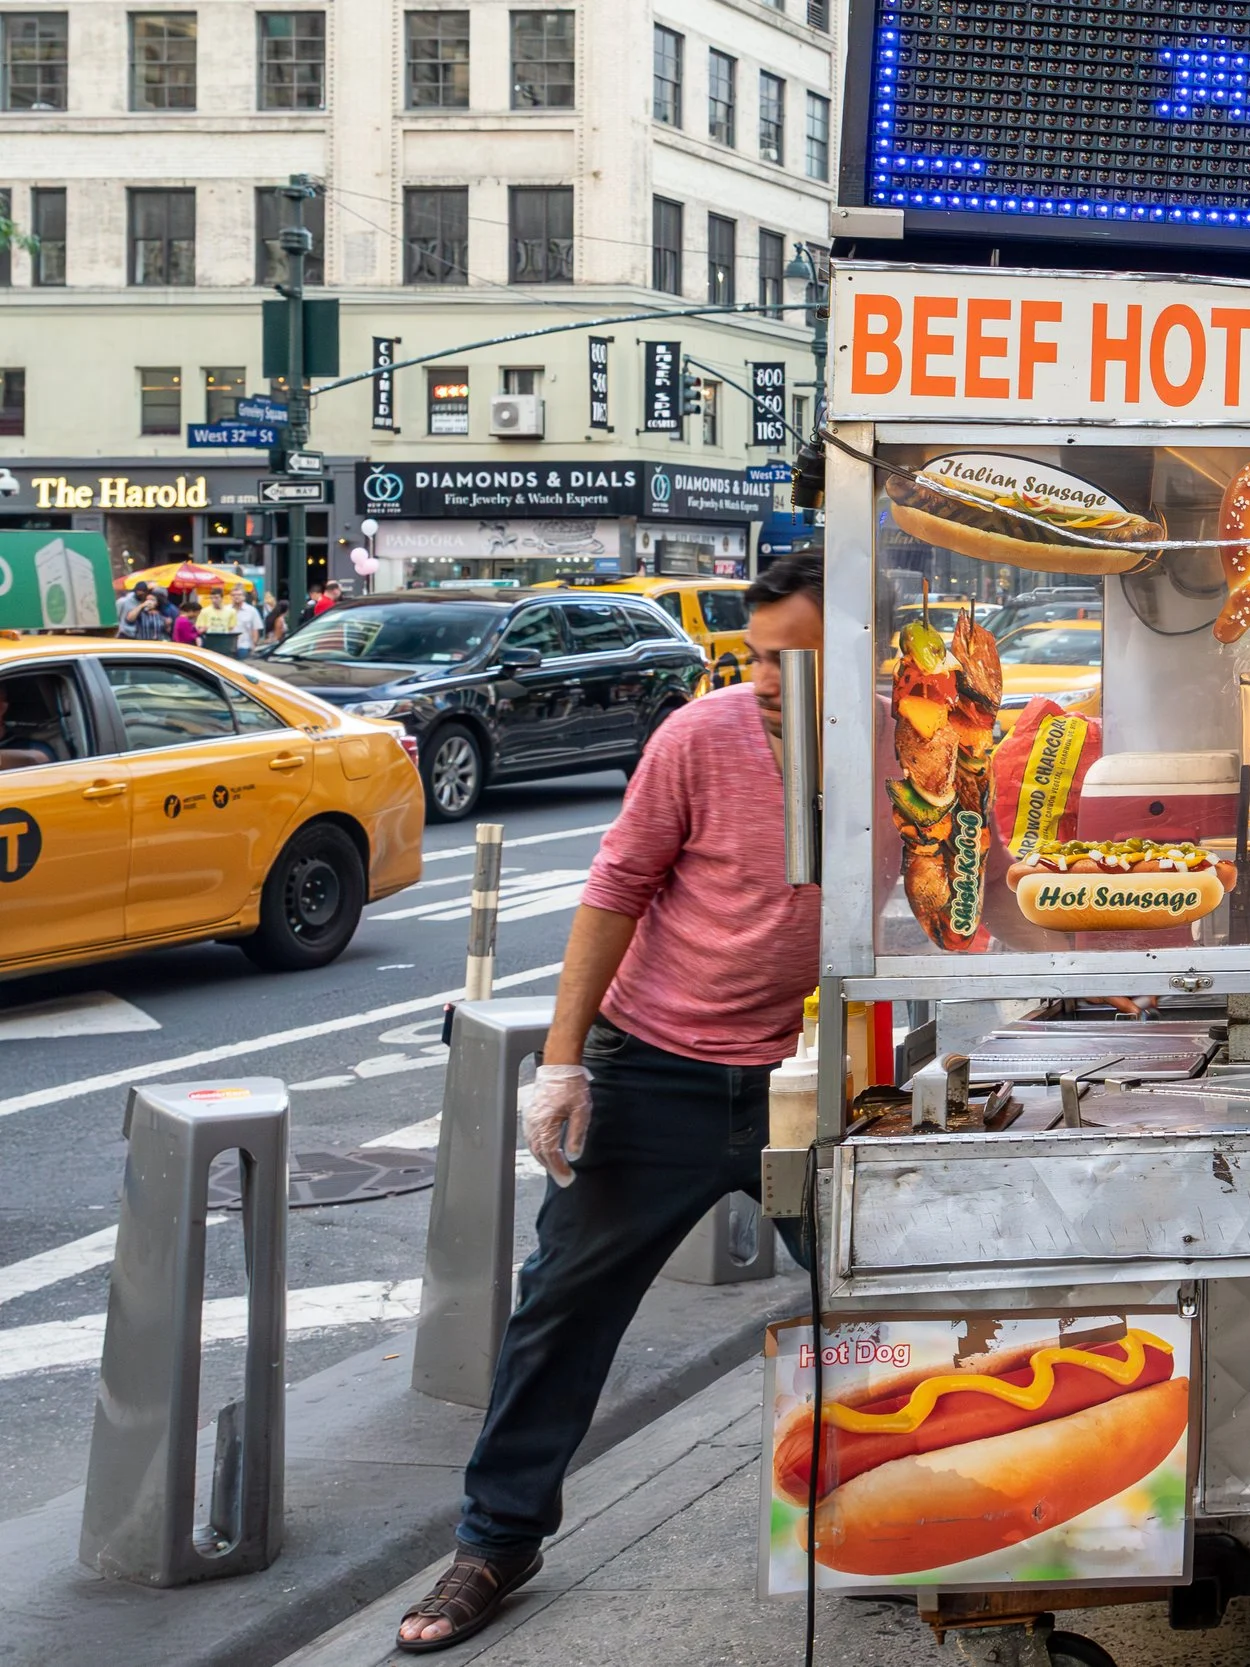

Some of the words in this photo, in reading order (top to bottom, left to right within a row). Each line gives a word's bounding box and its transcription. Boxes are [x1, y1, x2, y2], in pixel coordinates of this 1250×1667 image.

[851, 294, 1062, 400] BEEF
[756, 368, 783, 388] 800
[757, 394, 783, 414] 560
[194, 429, 228, 443] West
[230, 429, 257, 443] 32nd
[259, 429, 274, 443] St
[756, 421, 784, 441] 1165
[415, 471, 539, 488] DIAMONDS
[546, 471, 562, 488] &
[571, 471, 636, 488] DIALS
[675, 474, 731, 494] DIAMONDS
[732, 480, 740, 495] &
[742, 480, 771, 498] DIALS
[749, 470, 773, 480] West
[939, 458, 1017, 490] Italian
[1022, 475, 1108, 508] Sausage
[31, 476, 93, 508] The
[98, 475, 209, 508] Harold
[444, 493, 469, 505] Fine
[469, 493, 513, 508] Jewelry
[514, 494, 526, 505] &
[528, 494, 564, 505] Watch
[566, 494, 609, 507] Experts
[386, 532, 465, 547] PANDORA
[1033, 718, 1067, 786] CHARCOAL
[0, 821, 29, 873] T
[1038, 886, 1087, 907] Hot
[1094, 886, 1198, 913] Sausage
[799, 1343, 849, 1368] Hot
[855, 1340, 911, 1367] Dog
